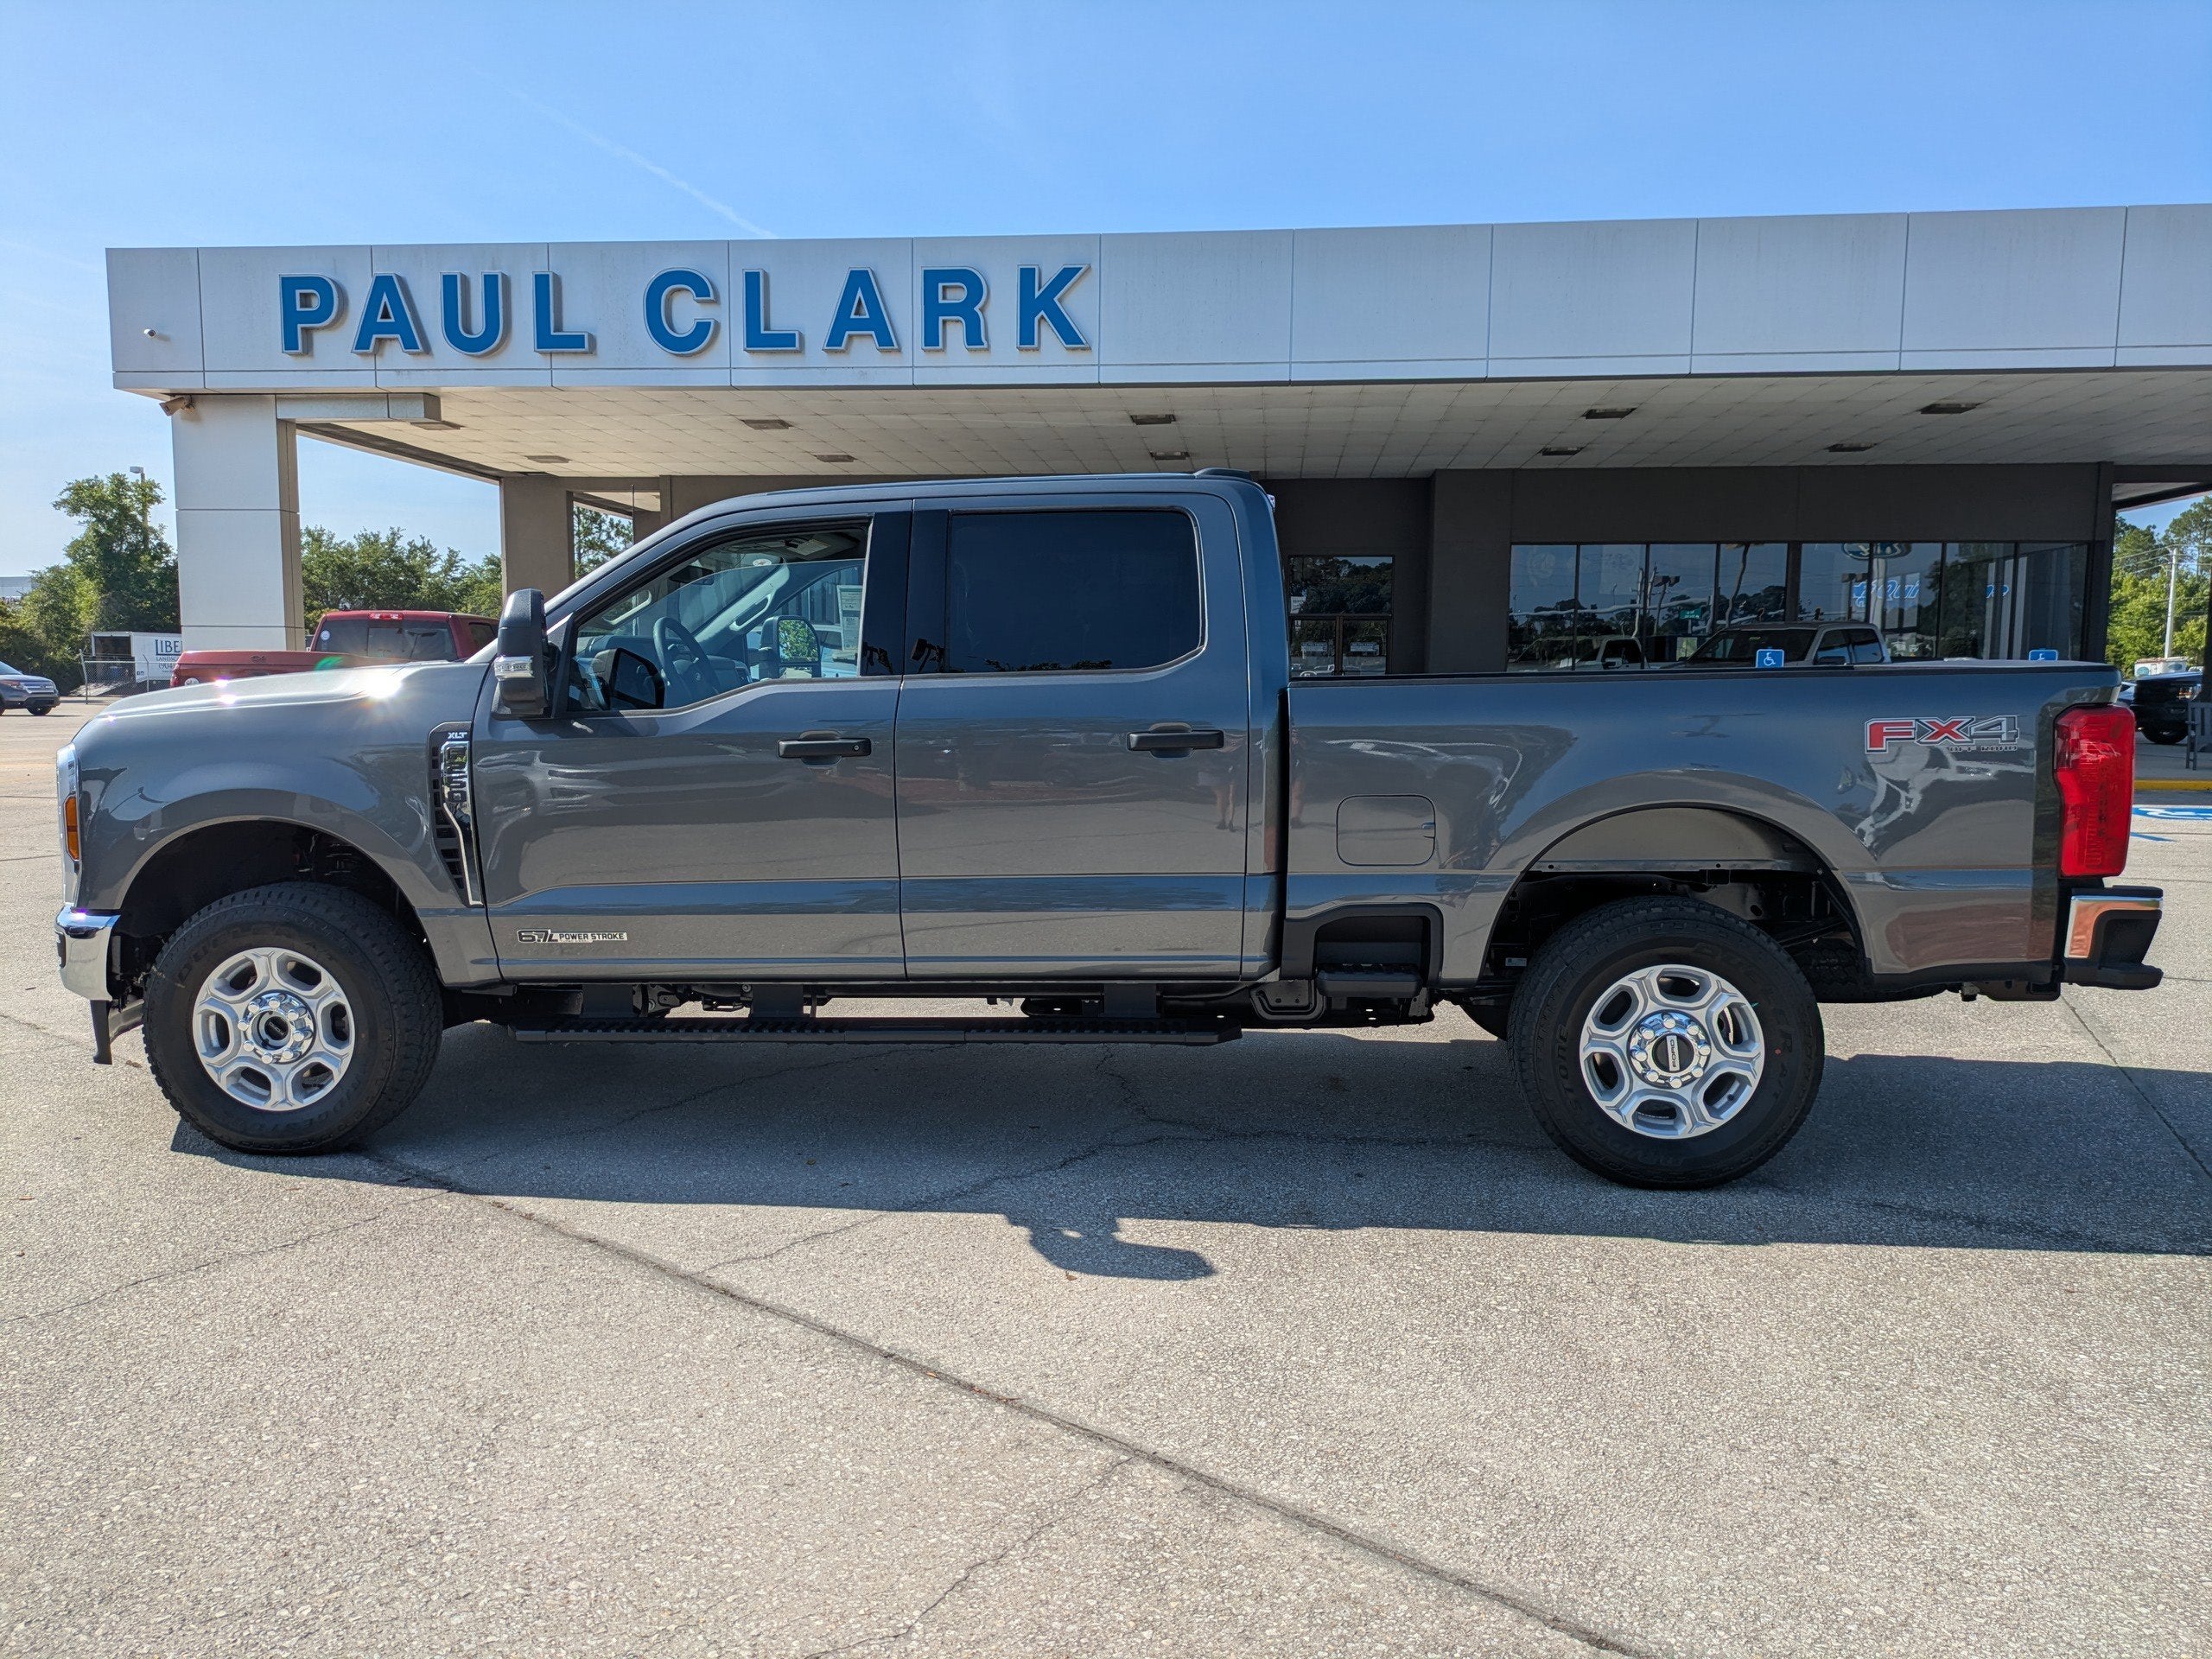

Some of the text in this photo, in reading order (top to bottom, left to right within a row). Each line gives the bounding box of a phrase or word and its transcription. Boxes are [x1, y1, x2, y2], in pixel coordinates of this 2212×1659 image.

[278, 263, 1092, 356] PAUL CLARK
[1865, 715, 2019, 753] FX4
[517, 929, 558, 943] 6.7L
